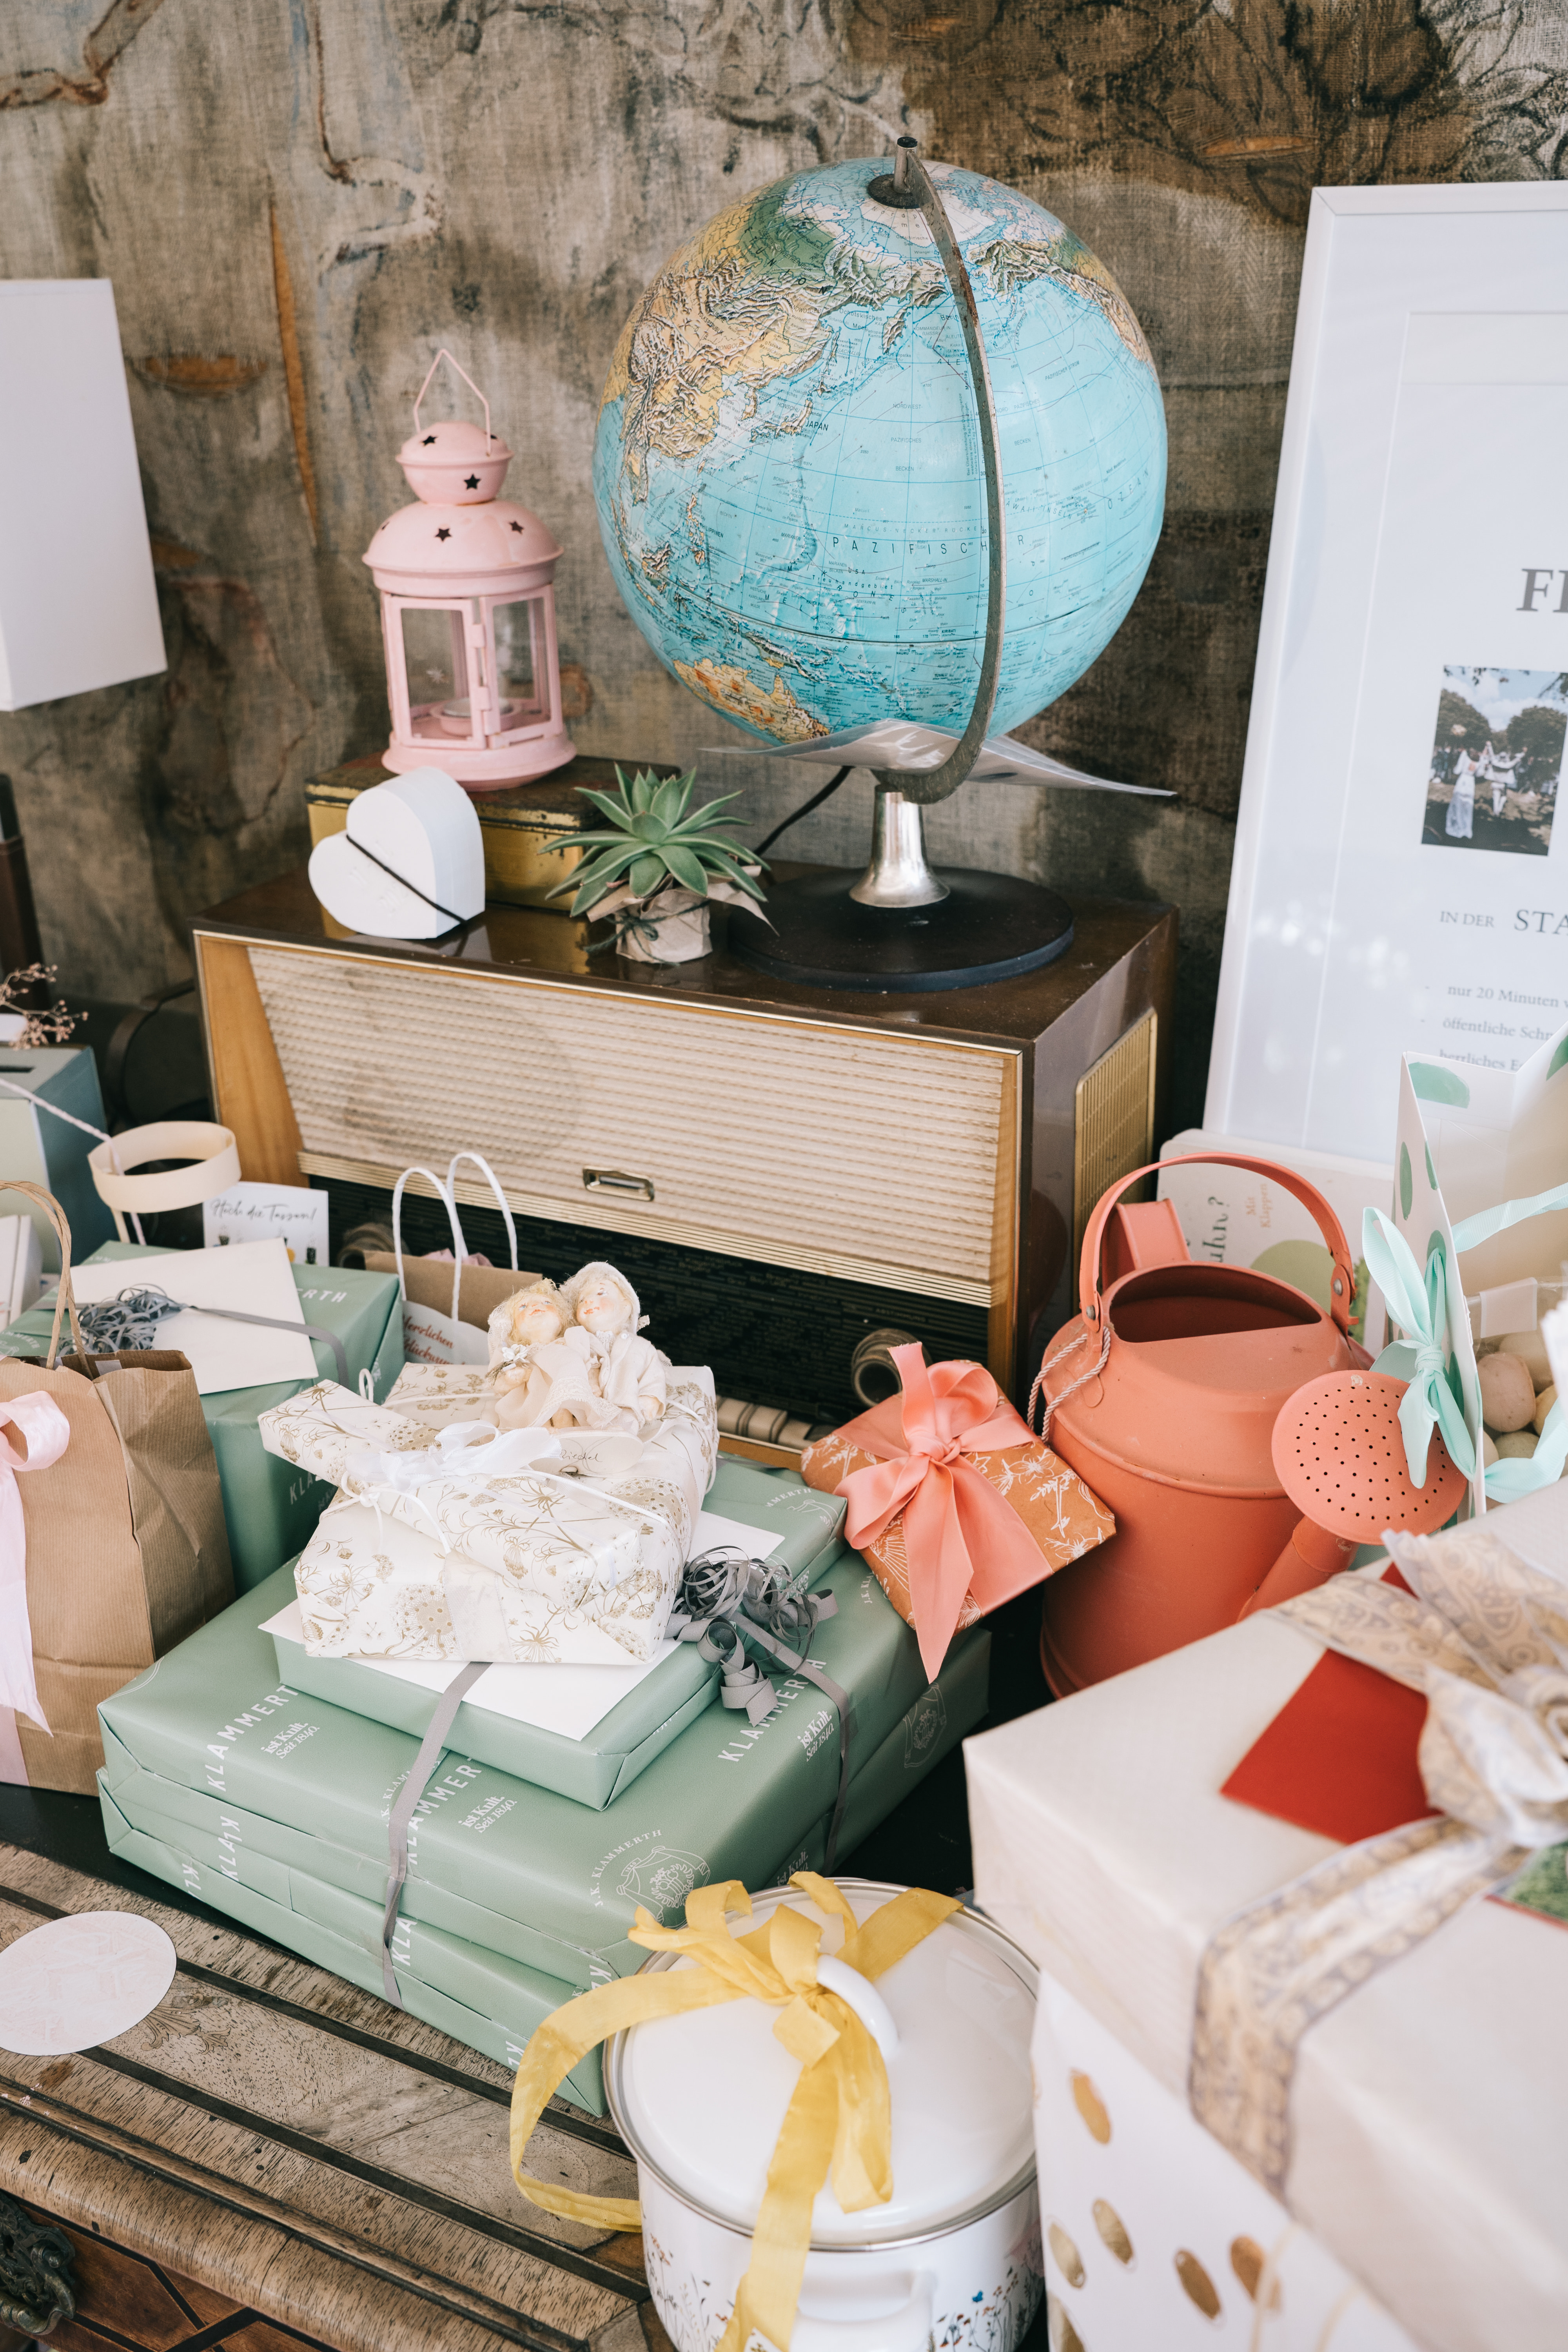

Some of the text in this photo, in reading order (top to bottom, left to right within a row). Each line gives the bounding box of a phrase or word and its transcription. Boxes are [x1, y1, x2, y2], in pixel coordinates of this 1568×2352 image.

[840, 309, 882, 321] Ochotskisches
[1045, 361, 1080, 381] PAZIFISCHER STROM
[759, 396, 771, 404] KOREA
[777, 402, 800, 412] HONSCHU
[1014, 399, 1040, 410] PAZIFISCHES
[806, 420, 829, 431] JAPAN
[1014, 438, 1031, 446] BECKEN
[700, 523, 724, 538] PHILIPPINEN
[781, 532, 801, 541] MARIANEN
[1440, 911, 1459, 923] IN
[1463, 913, 1495, 928] DER
[1448, 985, 1472, 997] nur
[1476, 987, 1494, 1000] 20
[1498, 989, 1559, 1008] Minuten
[1443, 1017, 1516, 1037] öffentliche
[297, 1288, 347, 1303] RTH
[717, 1659, 827, 1762] KLAERH
[261, 1722, 309, 1755] ist Kult.
[797, 1710, 833, 1749] ist Kult.
[276, 1725, 320, 1759] Seit 1840.
[806, 1723, 835, 1762] Seit 1840.
[458, 1796, 505, 1828] ist Kult.
[474, 1799, 517, 1833] Seit 1840.
[592, 1829, 662, 1878] KLAMMERTH
